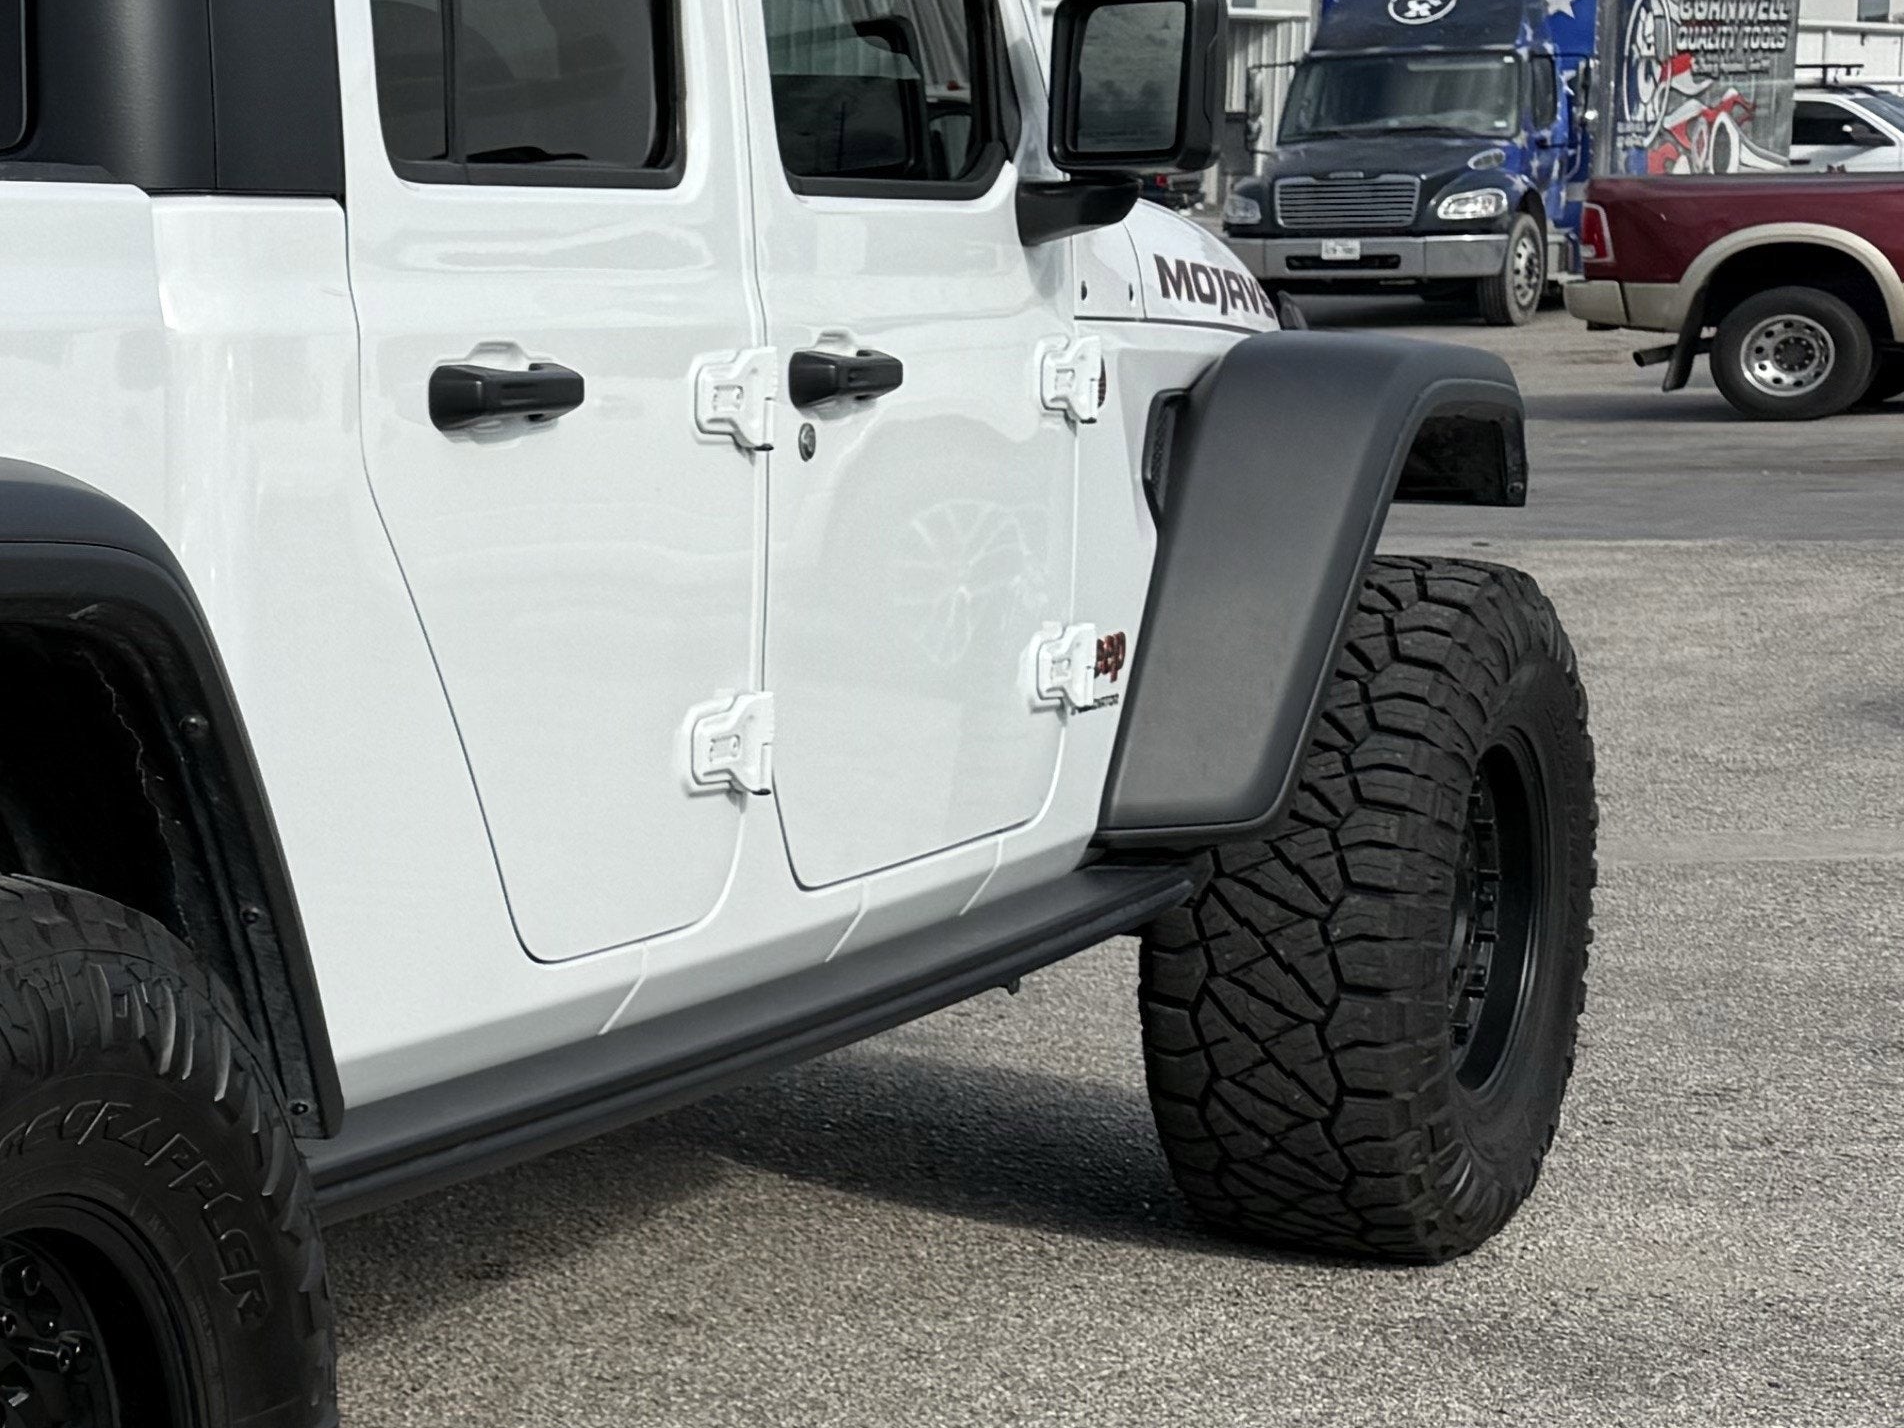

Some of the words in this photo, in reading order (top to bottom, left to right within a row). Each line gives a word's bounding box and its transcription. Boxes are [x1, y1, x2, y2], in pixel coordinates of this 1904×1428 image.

[1676, 26, 1739, 51] QUALITY
[1743, 26, 1788, 50] TOOLS
[1153, 253, 1276, 320] MOJAVE
